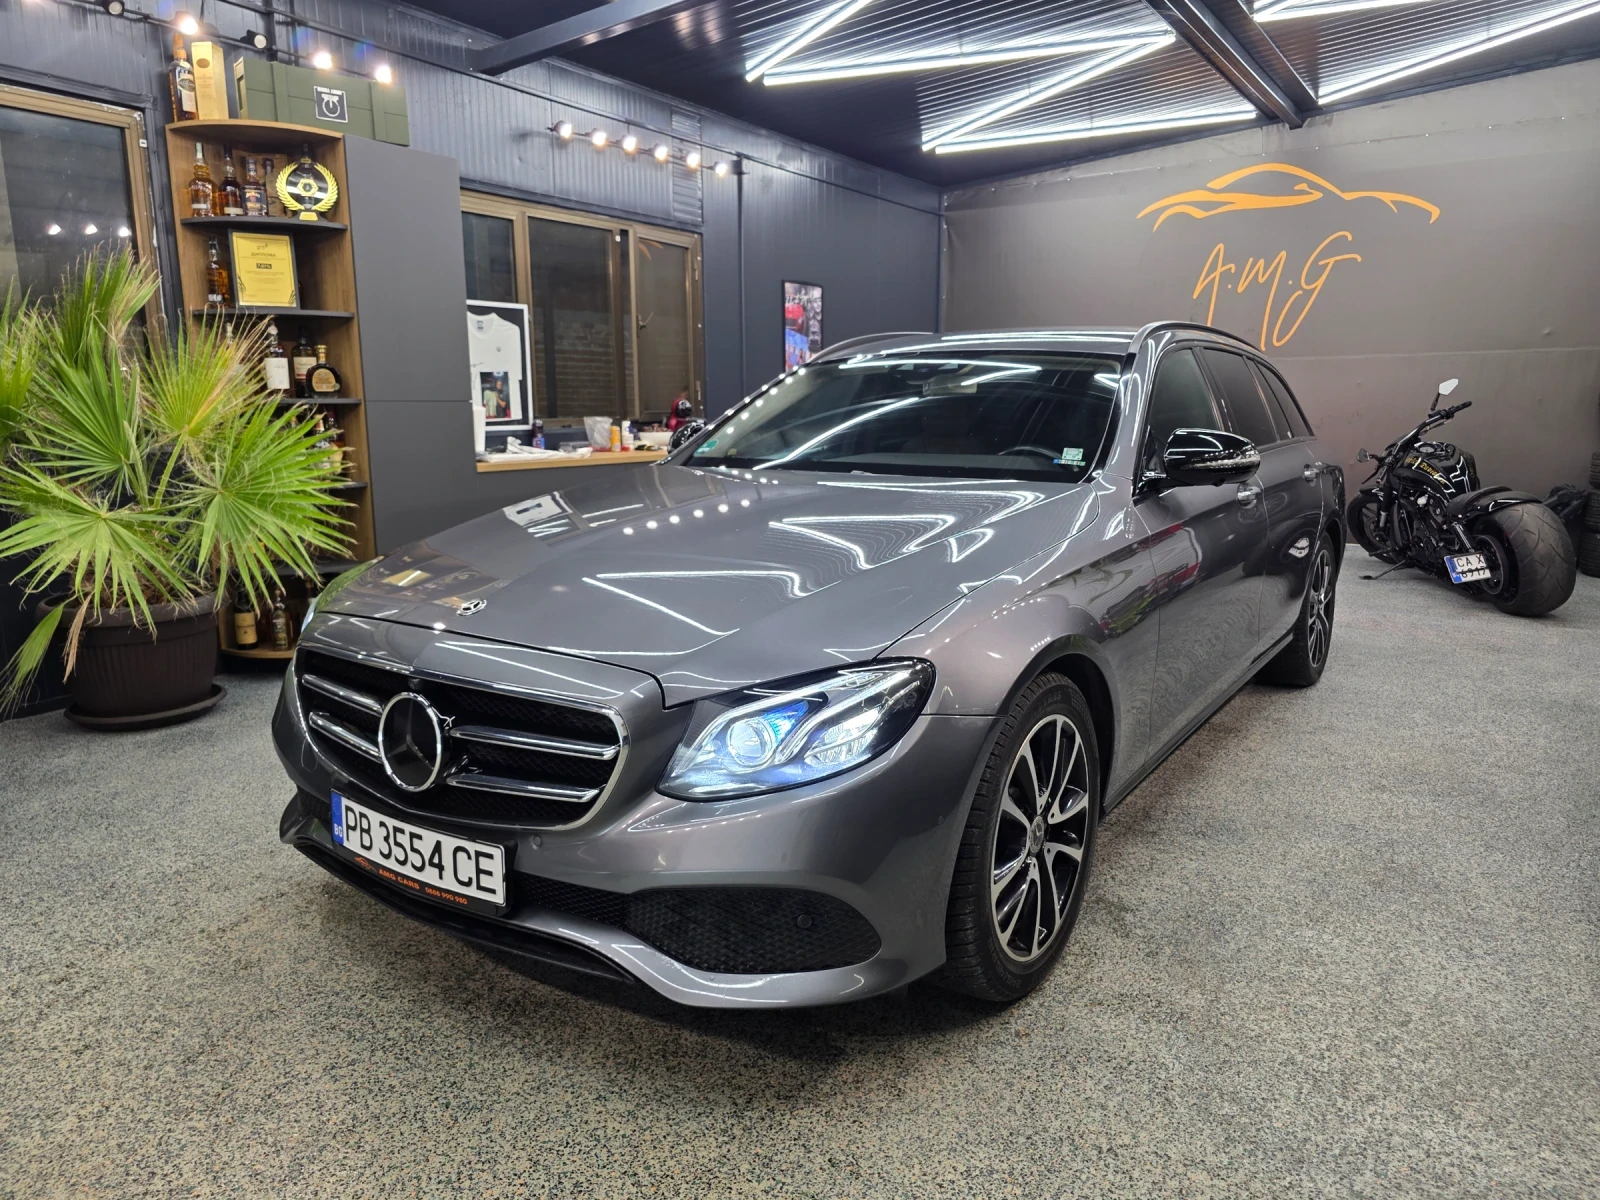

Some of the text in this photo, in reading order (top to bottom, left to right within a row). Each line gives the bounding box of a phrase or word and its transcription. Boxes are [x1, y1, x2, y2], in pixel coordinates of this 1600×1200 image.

[1193, 230, 1362, 352] A.M.G
[1456, 554, 1484, 568] CA X
[334, 823, 343, 838] BG
[344, 804, 497, 895] PB 3554 CE
[378, 868, 396, 881] AMG
[397, 876, 420, 890] CARS
